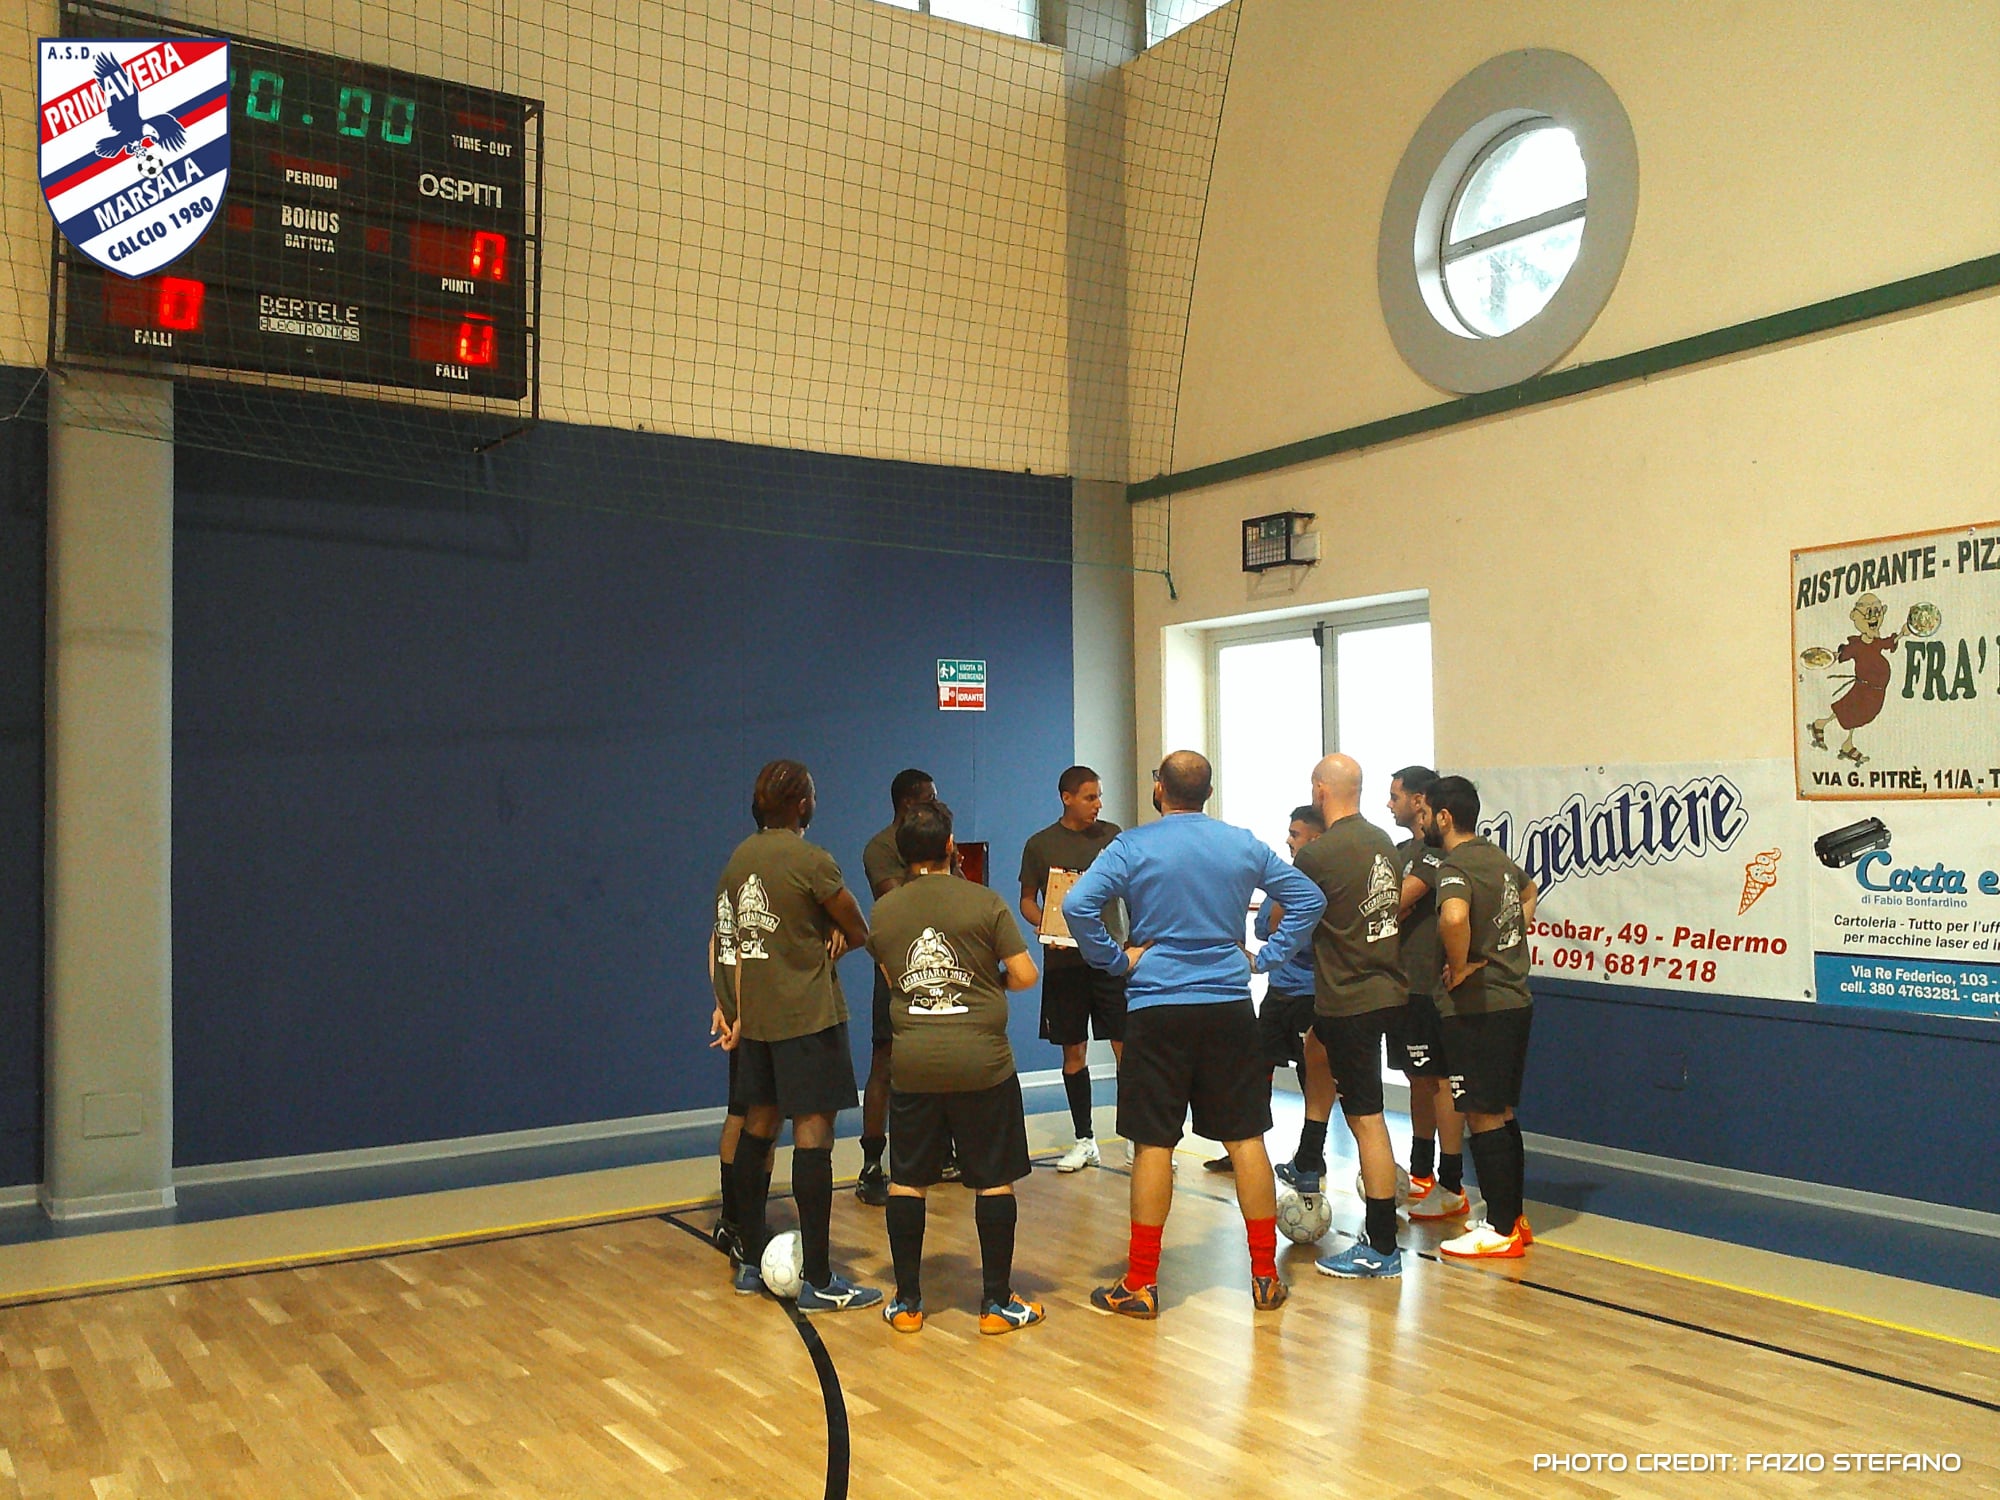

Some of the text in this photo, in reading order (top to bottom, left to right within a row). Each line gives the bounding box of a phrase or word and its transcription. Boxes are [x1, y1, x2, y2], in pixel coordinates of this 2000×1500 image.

[452, 134, 512, 157] TIME-OUT
[285, 169, 338, 190] PERIODI
[419, 173, 502, 208] OSPITI
[281, 205, 340, 234] BONUS
[285, 233, 335, 253] BATTUTA
[441, 277, 474, 295] PUNTI
[159, 276, 205, 330] 0
[260, 295, 360, 325] BERTELE
[134, 329, 172, 347] FALLI
[260, 316, 360, 341] ELECTRONICS
[435, 363, 469, 380] FALLI
[1796, 545, 1937, 610] RISTORANTE
[1957, 536, 2000, 574] PIZ
[1812, 771, 1842, 786] VIA
[1847, 771, 1864, 787] G.
[1870, 766, 1927, 793] PITRÈ,
[1933, 769, 1973, 789] 11/A
[1524, 783, 1745, 892] gelatiere
[1856, 850, 1968, 894] Carta
[1861, 895, 1968, 908] di Fabio Bonfardino
[1834, 915, 1896, 929] Cartoleria
[1909, 918, 1942, 931] Tutto
[1946, 921, 1968, 934] per
[1617, 923, 1648, 945] 49
[1673, 926, 1788, 955] Palermo
[1843, 933, 1864, 945] per
[1868, 934, 1931, 947] macchine
[1936, 937, 1969, 949] laser
[1972, 938, 1989, 950] ed
[1553, 948, 1595, 972] 091
[902, 968, 949, 988] AGRIFARM
[1851, 965, 1872, 979] Via
[1875, 967, 1893, 980] Re
[1895, 968, 1957, 987] Federico,
[1960, 973, 1988, 987] 103
[1840, 981, 1866, 994] cell.
[1869, 982, 1895, 996] 380
[1898, 984, 1960, 1001] 4763281
